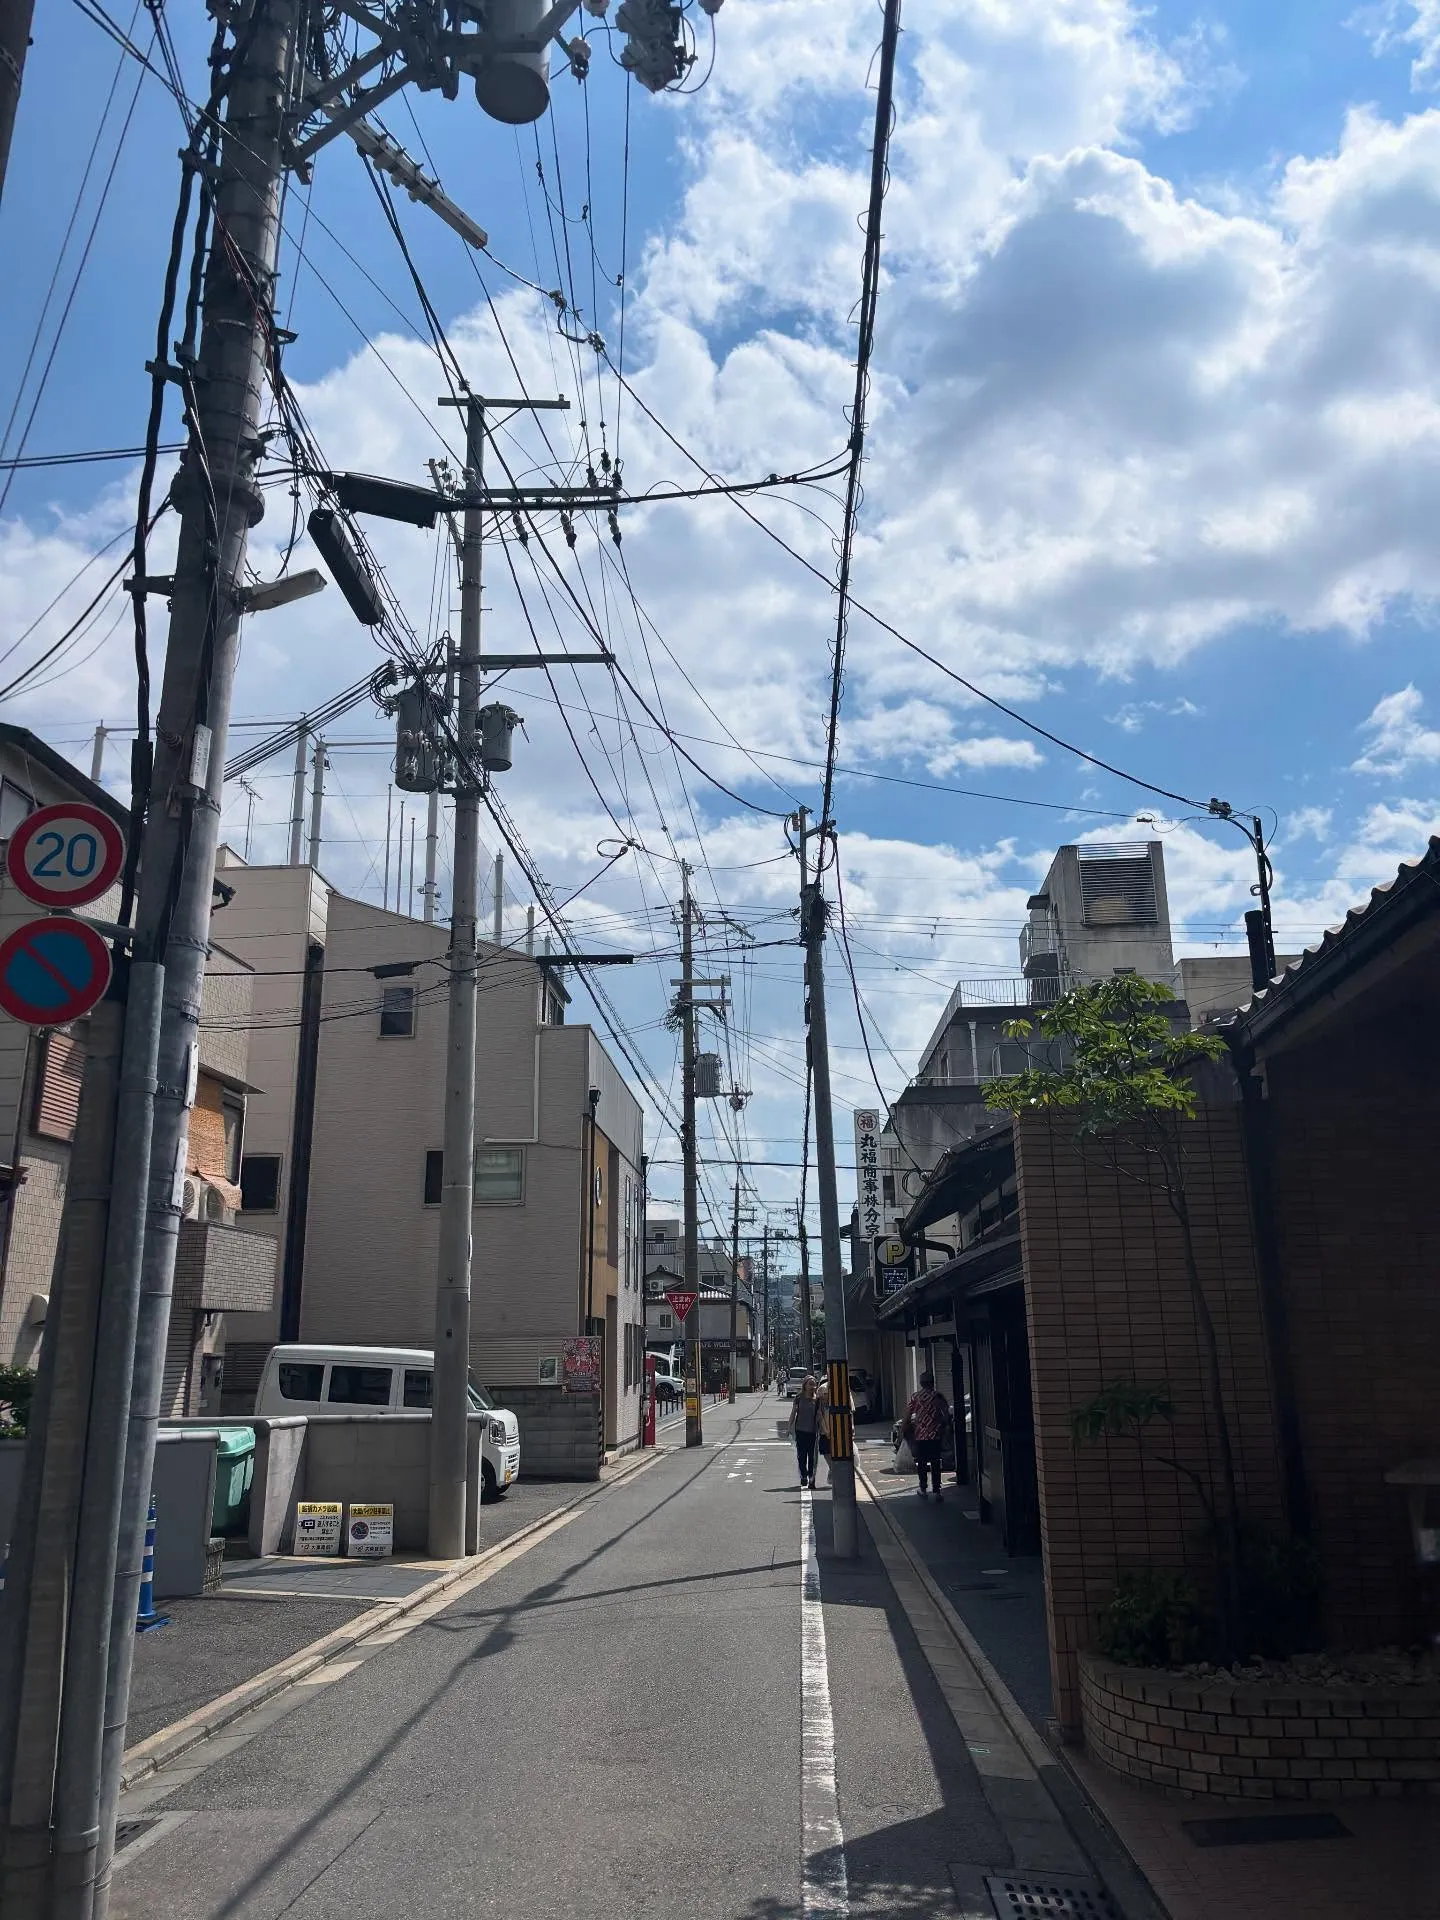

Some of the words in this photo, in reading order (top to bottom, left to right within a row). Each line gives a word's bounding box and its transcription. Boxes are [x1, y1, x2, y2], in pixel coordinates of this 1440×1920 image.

[33, 831, 97, 877] 20
[860, 1115, 874, 1129] 福
[886, 1240, 905, 1264] P
